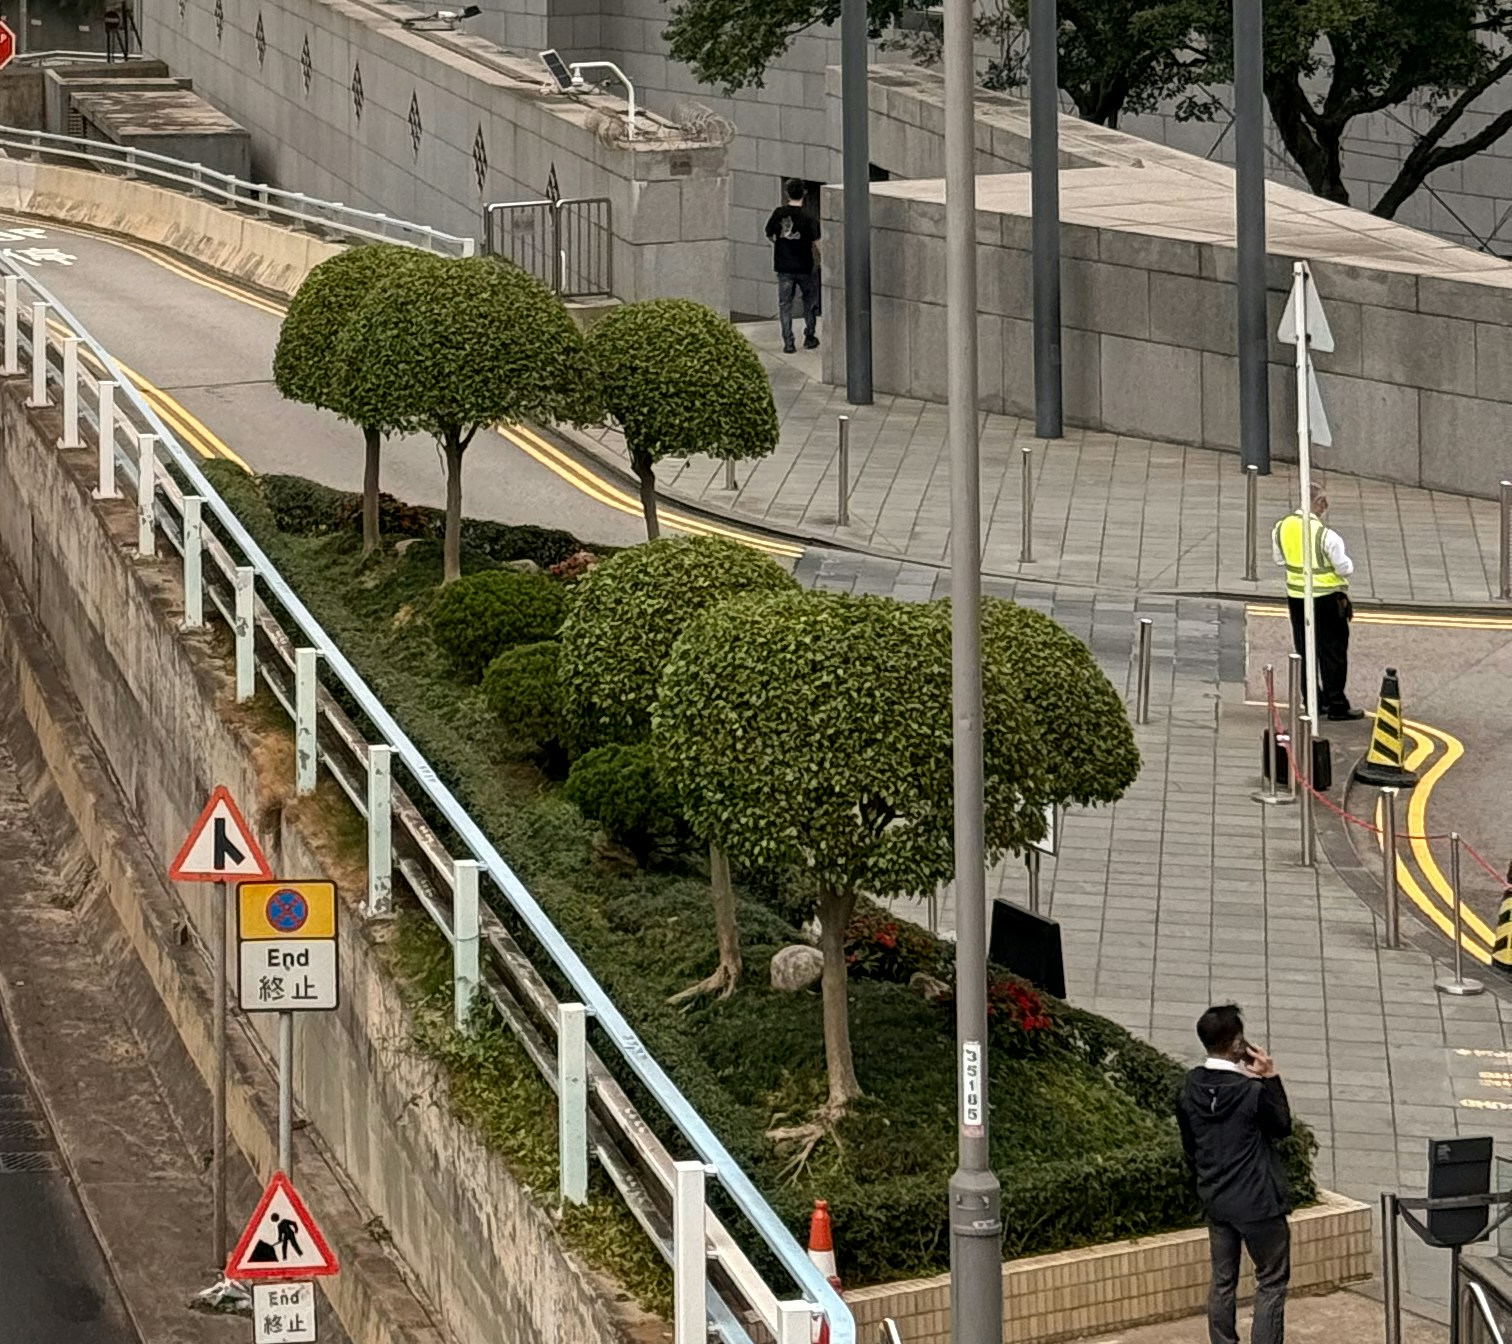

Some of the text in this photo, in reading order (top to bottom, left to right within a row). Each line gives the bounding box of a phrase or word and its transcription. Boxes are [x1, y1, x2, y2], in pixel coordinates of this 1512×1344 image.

[267, 948, 310, 968] End
[258, 975, 318, 1002] 終止
[268, 1289, 300, 1307] End
[263, 1313, 307, 1335] 終止
